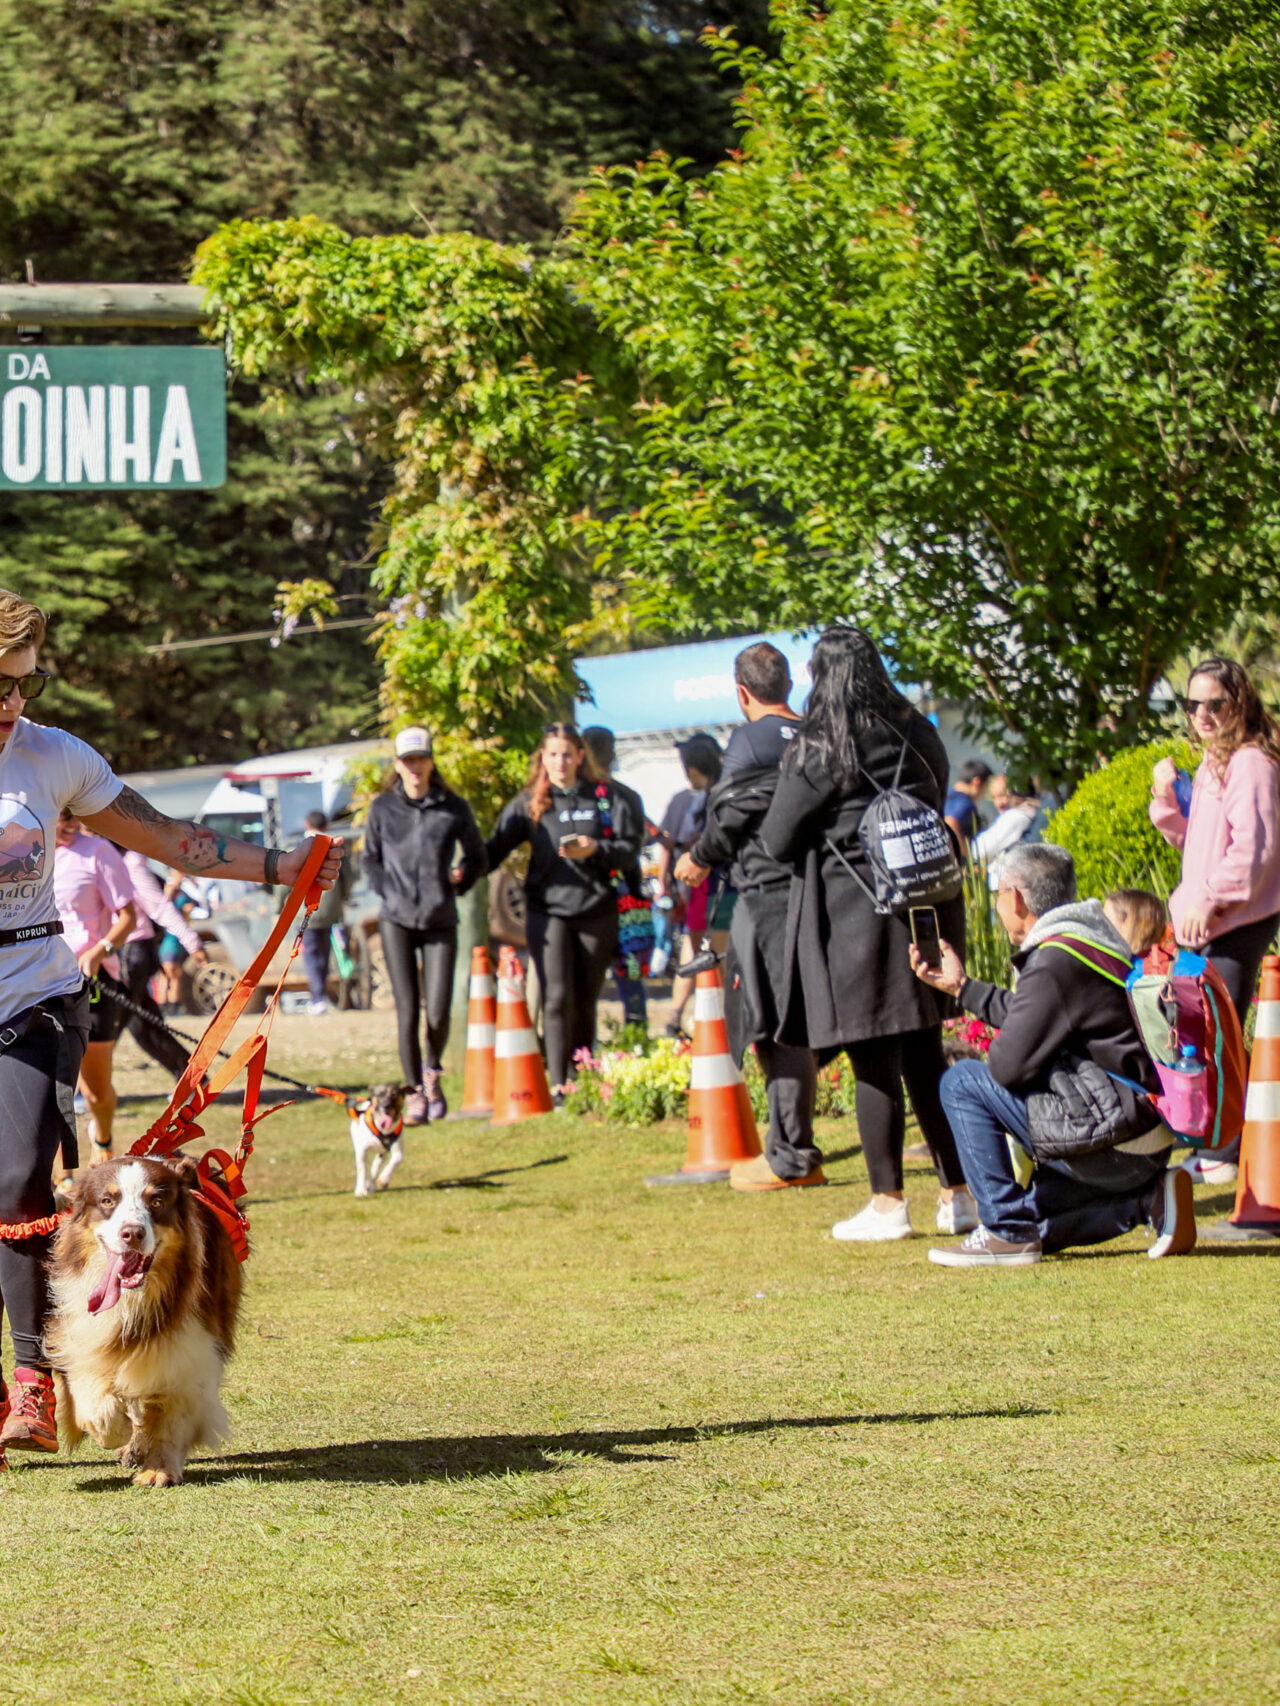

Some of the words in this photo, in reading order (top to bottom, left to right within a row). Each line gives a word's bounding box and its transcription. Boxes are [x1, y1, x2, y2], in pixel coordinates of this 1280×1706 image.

[8, 353, 51, 380] DA
[3, 911, 20, 919] JAP
[16, 926, 48, 940] KIPRUN
